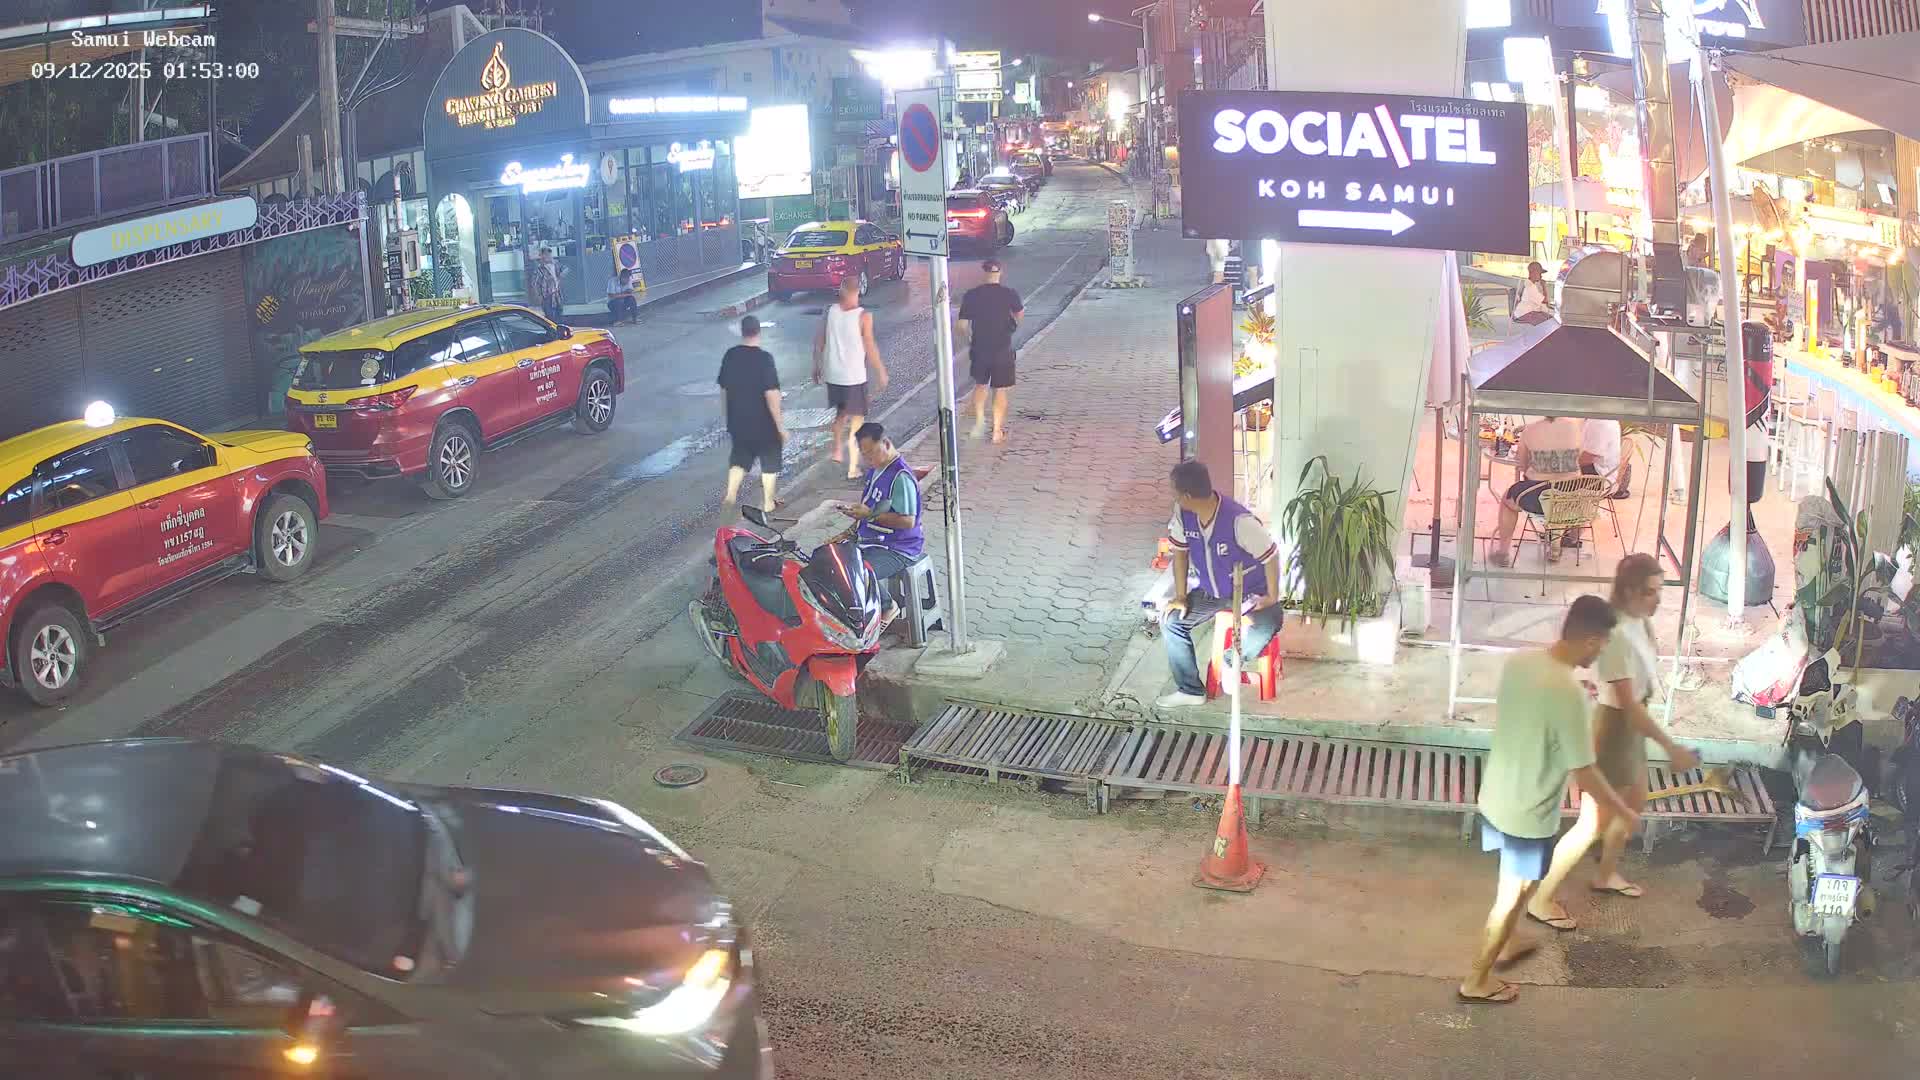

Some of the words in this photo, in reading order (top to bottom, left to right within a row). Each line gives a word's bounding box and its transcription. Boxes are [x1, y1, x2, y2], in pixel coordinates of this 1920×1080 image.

[1258, 178, 1326, 199] KOH
[1345, 182, 1455, 206] SAMUI
[775, 210, 813, 221] EXCHANGE
[907, 212, 916, 221] NO
[916, 213, 940, 222] PARKING
[111, 209, 224, 252] DISPENSARY
[160, 503, 206, 533] แท็กซี่บุคคล
[1216, 542, 1229, 556] 12
